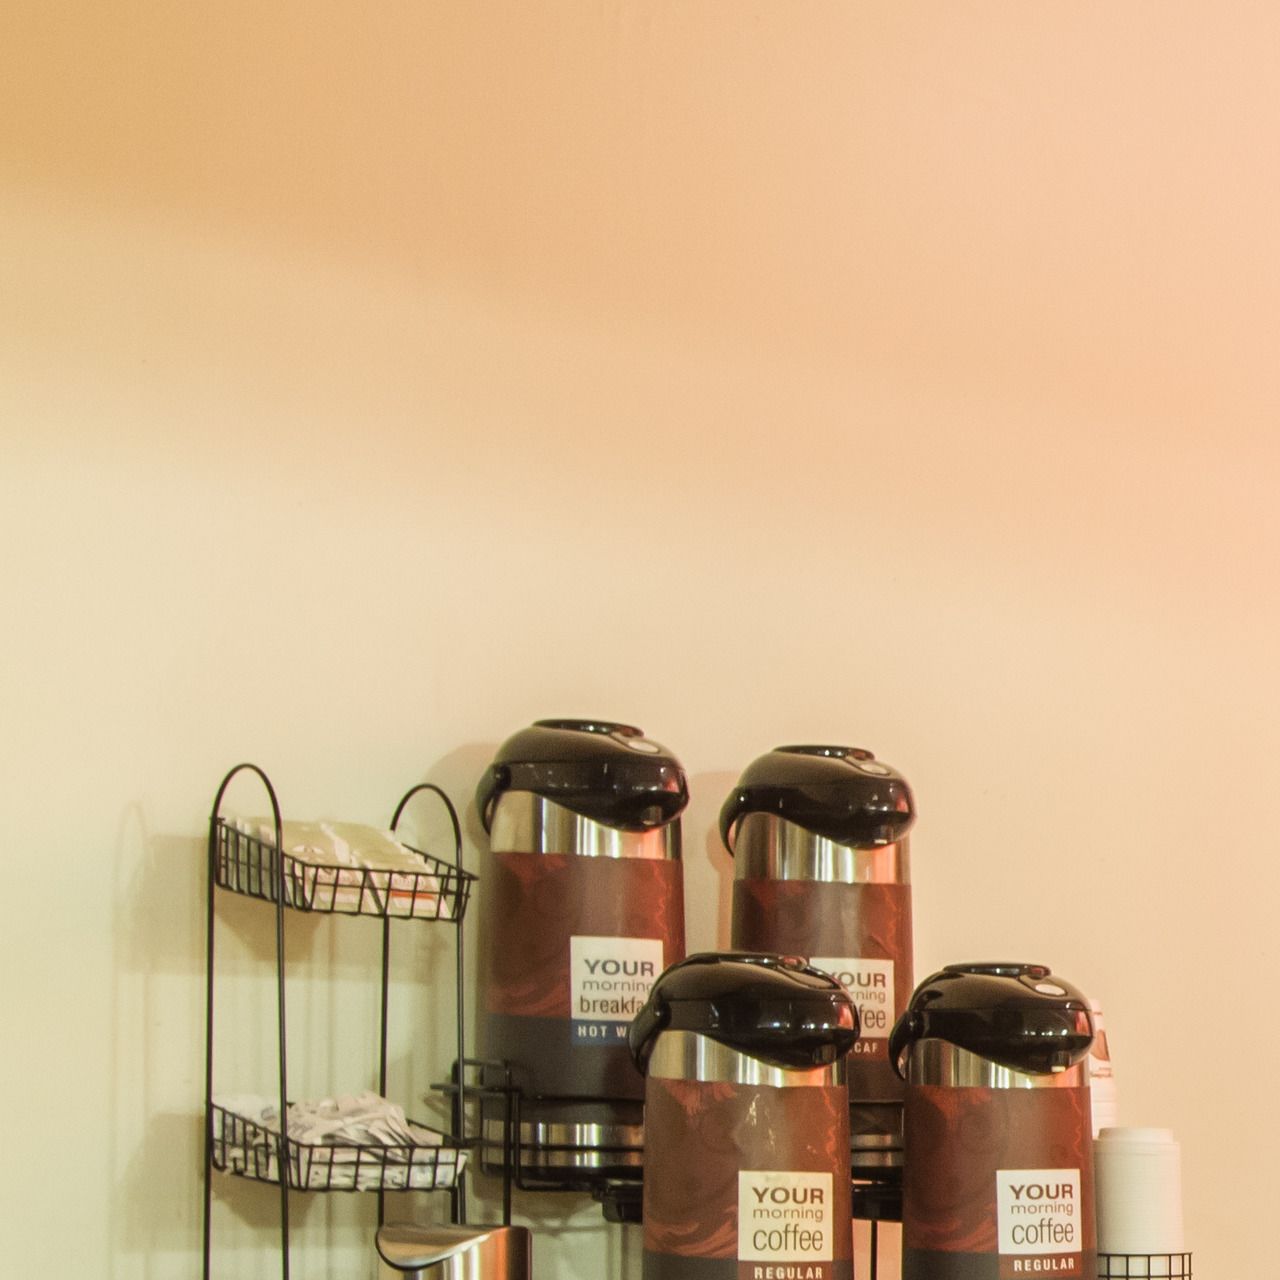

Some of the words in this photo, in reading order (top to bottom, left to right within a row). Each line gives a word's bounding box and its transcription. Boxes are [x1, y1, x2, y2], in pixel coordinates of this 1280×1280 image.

[584, 959, 654, 977] YOUR
[580, 995, 645, 1014] breakfa
[852, 990, 886, 1004] ning
[858, 1004, 886, 1029] fee
[577, 1025, 607, 1038] HOT
[853, 1042, 878, 1053] CAF
[752, 1187, 824, 1204] YOUR
[1009, 1184, 1073, 1200] YOUR
[753, 1207, 823, 1222] morning
[1010, 1202, 1073, 1216] morning
[753, 1224, 823, 1251] coffee
[1012, 1218, 1074, 1245] coffee
[1014, 1257, 1074, 1272] REGULAR
[754, 1267, 823, 1280] REGULAR
